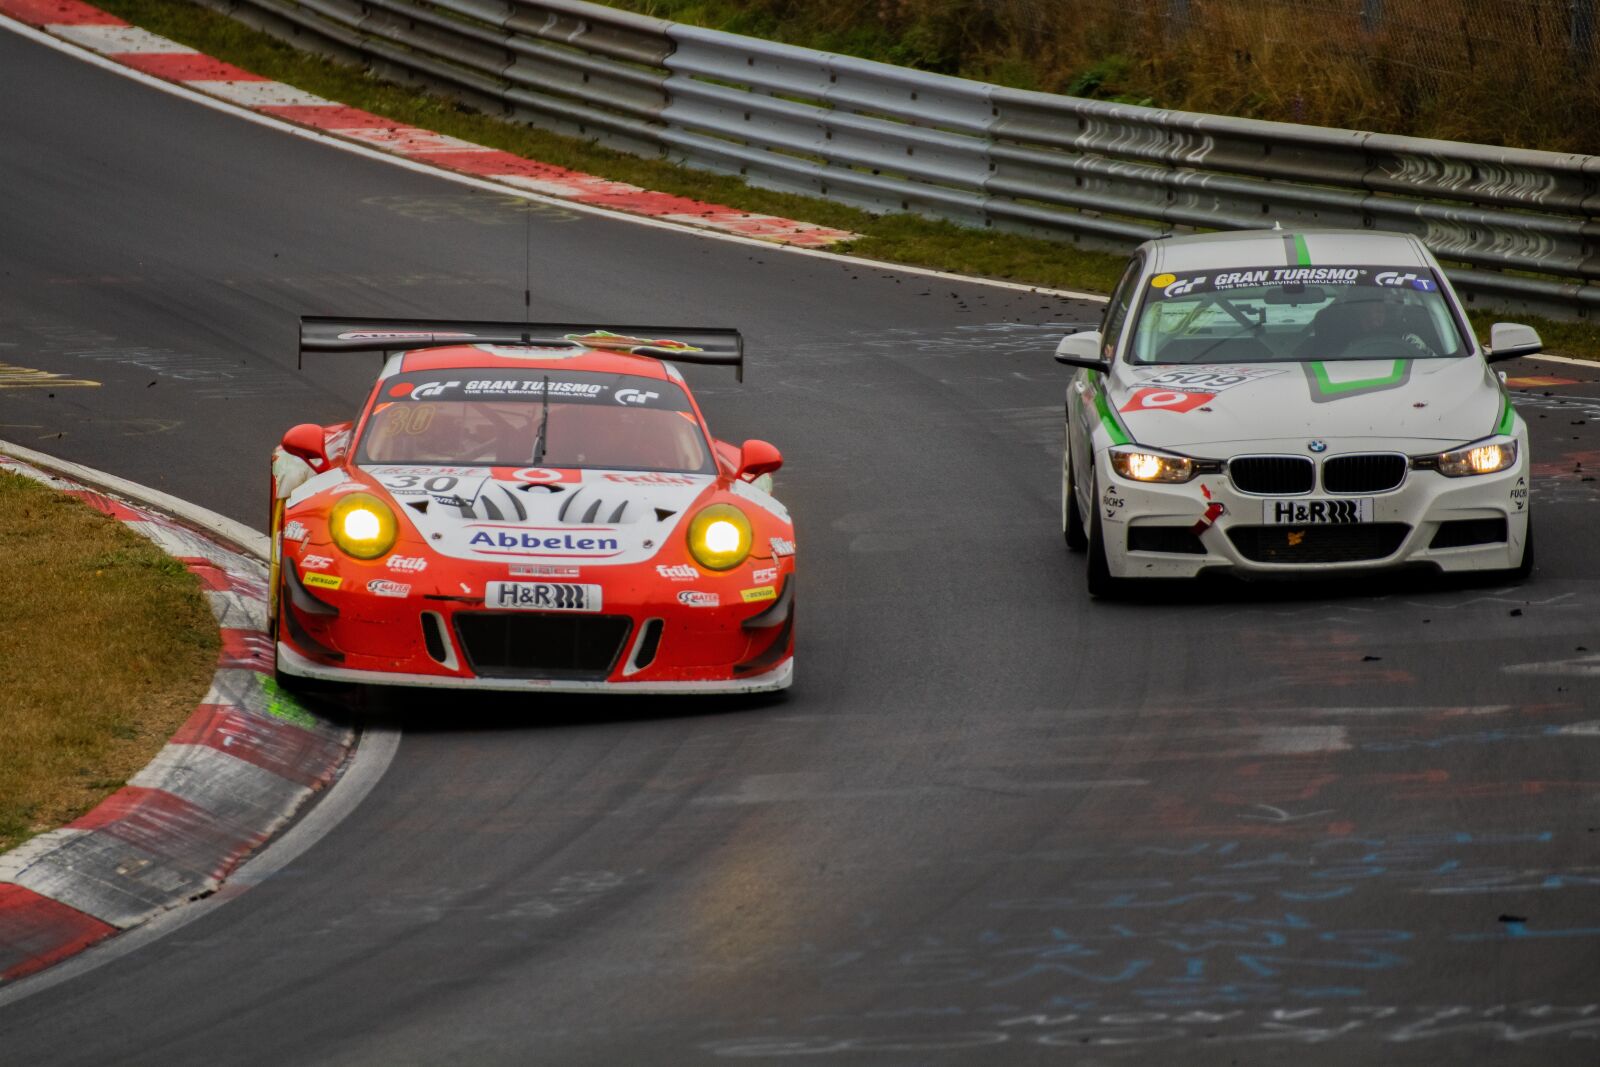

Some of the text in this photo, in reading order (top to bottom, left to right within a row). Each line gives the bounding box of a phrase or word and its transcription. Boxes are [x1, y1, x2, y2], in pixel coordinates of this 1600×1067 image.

[1214, 268, 1359, 286] GRAN TURISMO
[465, 380, 520, 390] GRAN
[1151, 371, 1248, 387] 509
[386, 404, 437, 437] 30
[385, 475, 460, 493] 30
[468, 531, 618, 550] Abbelen
[310, 576, 338, 586] DUNLOP
